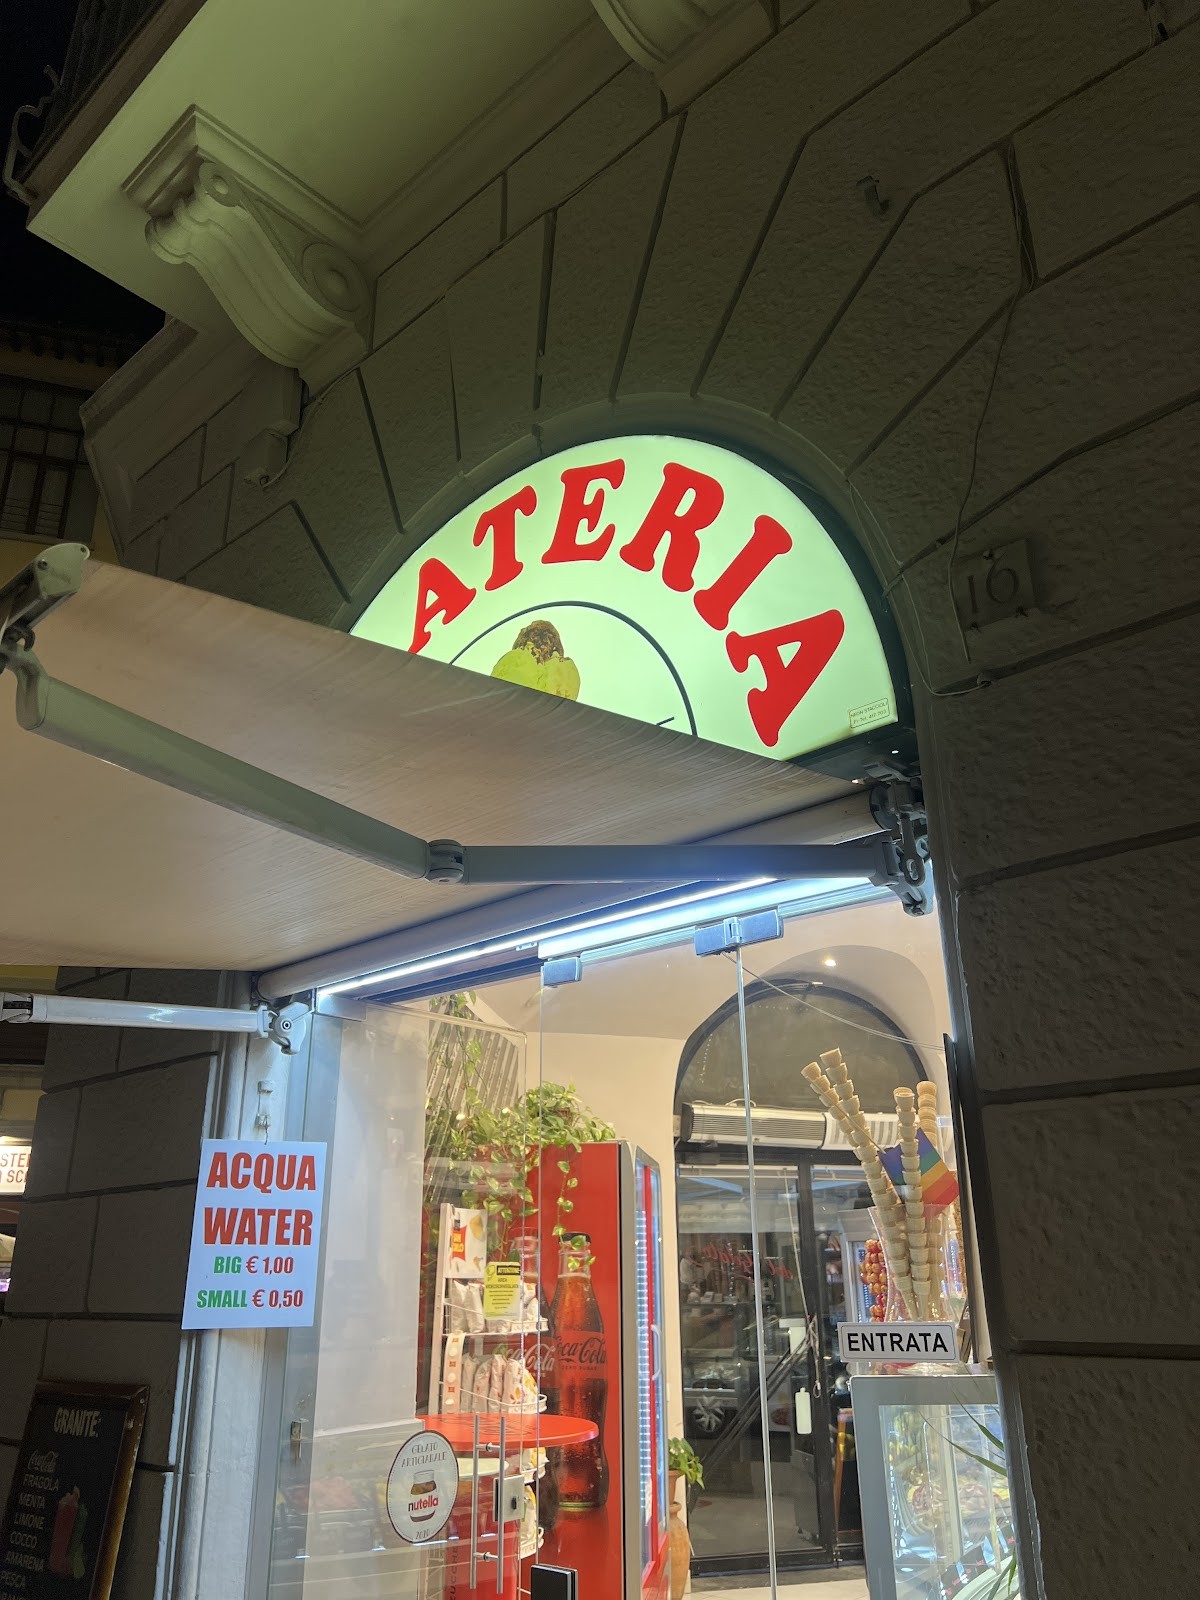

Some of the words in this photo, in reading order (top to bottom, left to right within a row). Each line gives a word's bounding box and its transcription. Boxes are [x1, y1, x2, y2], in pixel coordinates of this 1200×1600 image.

[408, 458, 846, 747] ATERIA
[206, 1151, 317, 1194] ACQUA
[203, 1206, 314, 1246] WATER
[213, 1256, 242, 1274] BIG
[245, 1255, 259, 1274] €
[262, 1256, 294, 1275] 1,00
[196, 1289, 248, 1309] SMALL
[251, 1288, 266, 1308] €
[268, 1289, 304, 1309] 0,50
[847, 1332, 949, 1353] ENTRATA
[411, 1442, 439, 1455] GELATO
[23, 1473, 59, 1492] FRAGOLA
[18, 1492, 45, 1509] MENTA
[408, 1494, 439, 1512] nutella
[14, 1512, 45, 1530] LIMONE
[9, 1531, 38, 1549] COCCO
[5, 1551, 45, 1572] AMARENA
